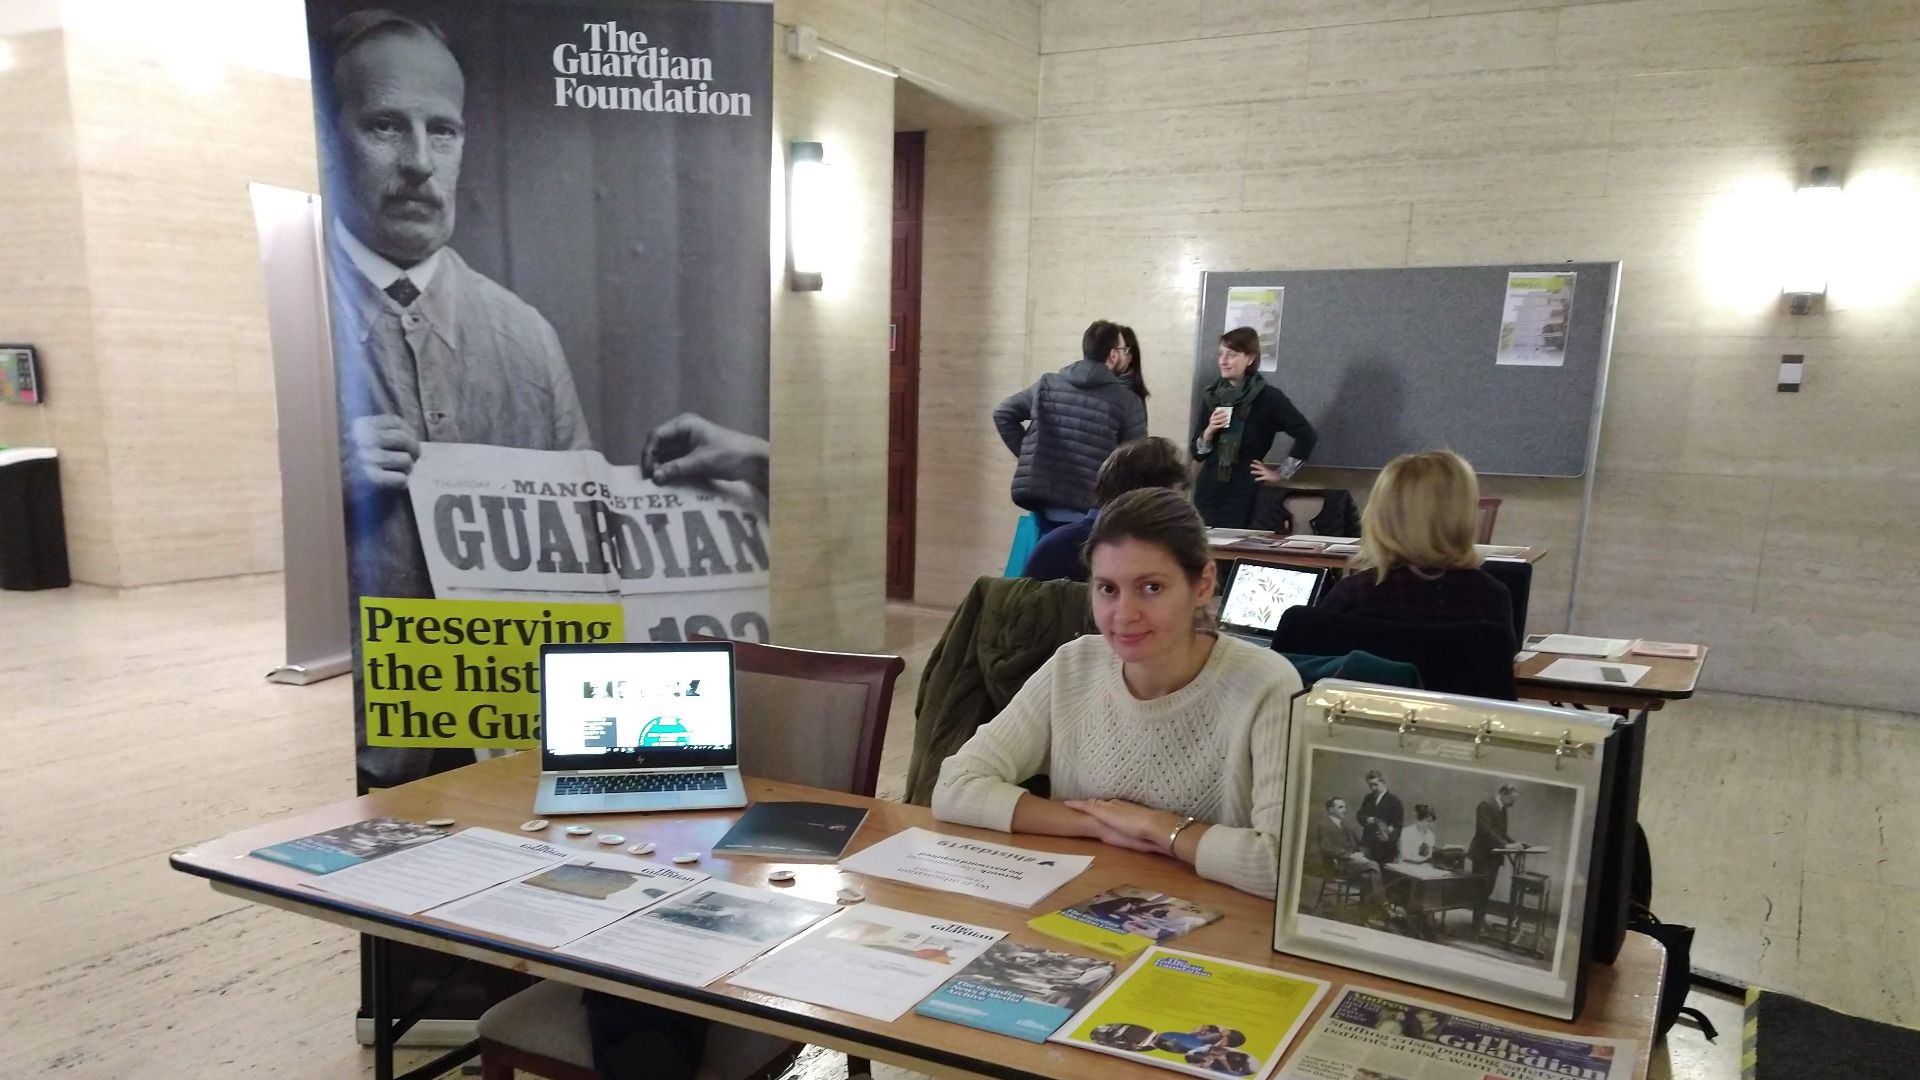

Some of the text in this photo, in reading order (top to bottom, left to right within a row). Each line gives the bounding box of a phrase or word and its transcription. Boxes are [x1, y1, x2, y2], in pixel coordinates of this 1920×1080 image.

[583, 21, 648, 54] The
[553, 43, 713, 81] Guardian
[554, 77, 752, 116] Foundation
[513, 480, 683, 510] MANCHSTER
[434, 494, 769, 580] GUARDIAN
[365, 607, 611, 646] Preserving
[367, 653, 540, 694] the hist
[369, 701, 457, 738] The
[937, 840, 1037, 863] #histday19
[946, 989, 986, 1000] Archive
[950, 984, 978, 994] News
[988, 992, 1021, 1003] Media
[958, 981, 1024, 999] The Guardian
[1323, 1027, 1388, 1047] patients
[1390, 1043, 1405, 1052] at
[1449, 1057, 1491, 1072] warn
[1329, 1020, 1389, 1040] Staffing
[1392, 1036, 1435, 1050] crisis
[1438, 1047, 1499, 1067] putting
[1438, 1034, 1607, 1080] Guardian
[1476, 1033, 1539, 1056] The
